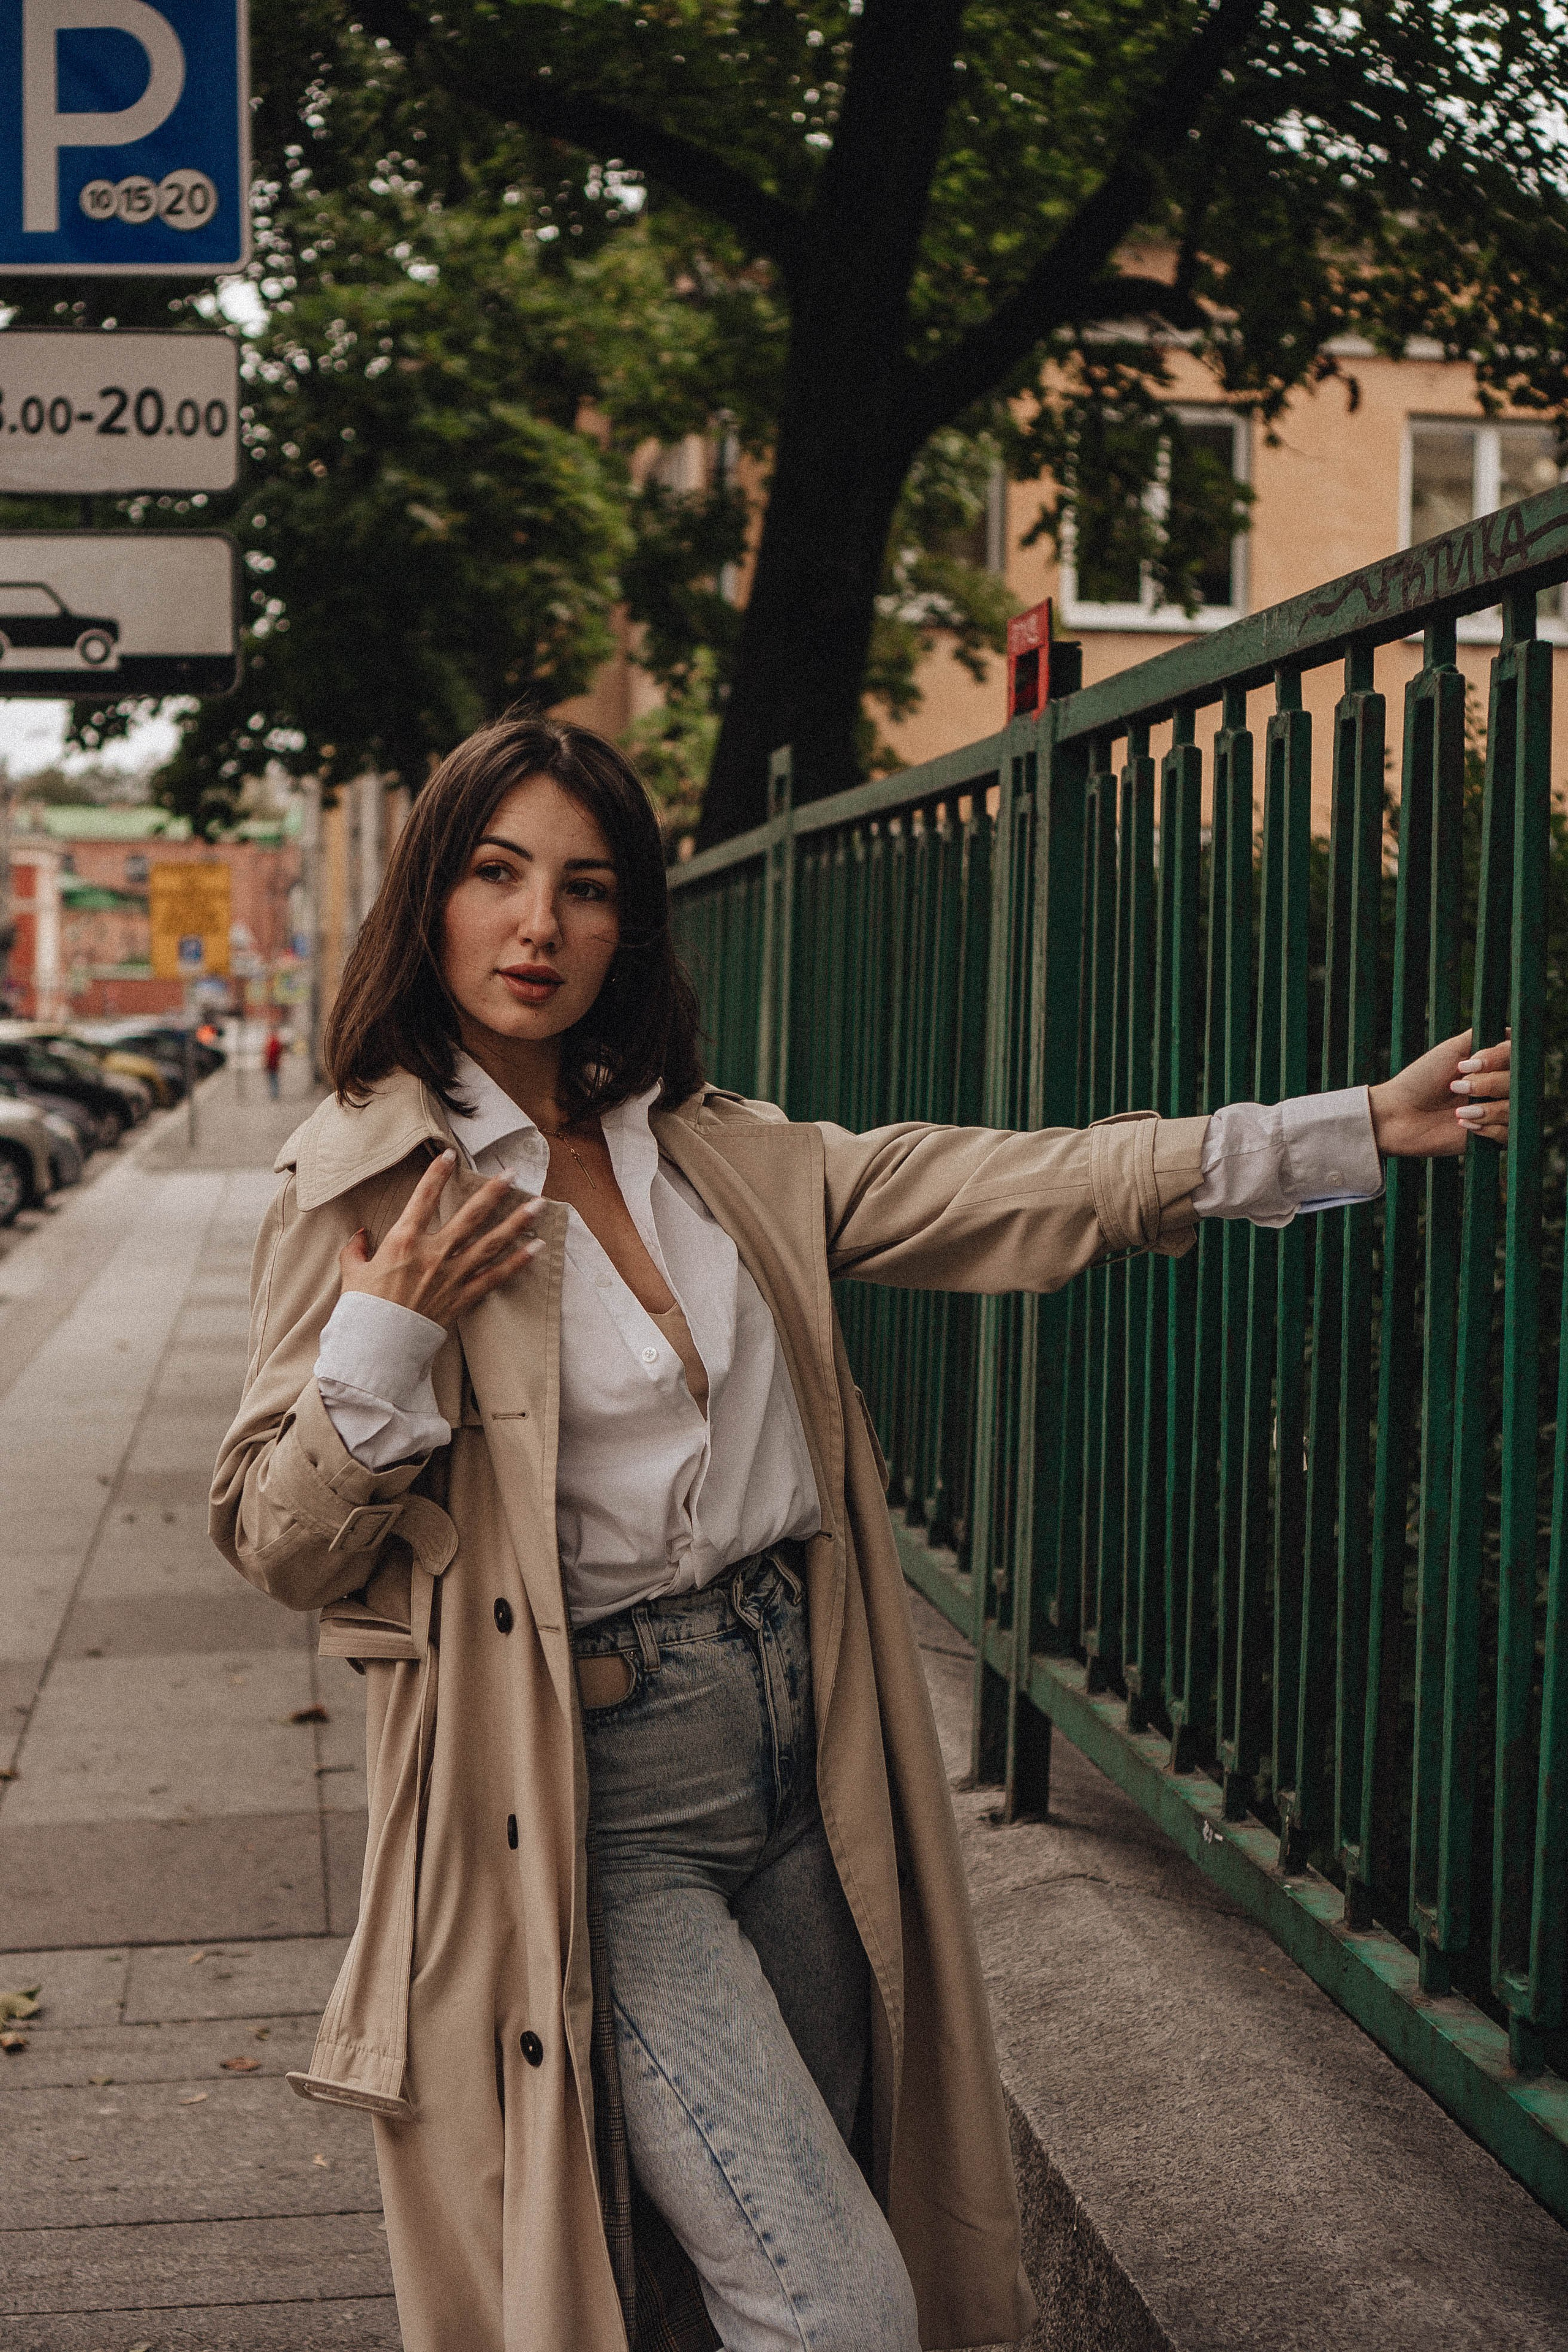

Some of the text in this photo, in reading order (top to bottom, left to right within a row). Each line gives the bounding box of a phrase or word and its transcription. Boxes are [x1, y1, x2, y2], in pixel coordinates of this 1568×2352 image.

[22, 0, 186, 233] P
[88, 183, 210, 216] 10 15 20
[0, 385, 228, 437] .00-20.00
